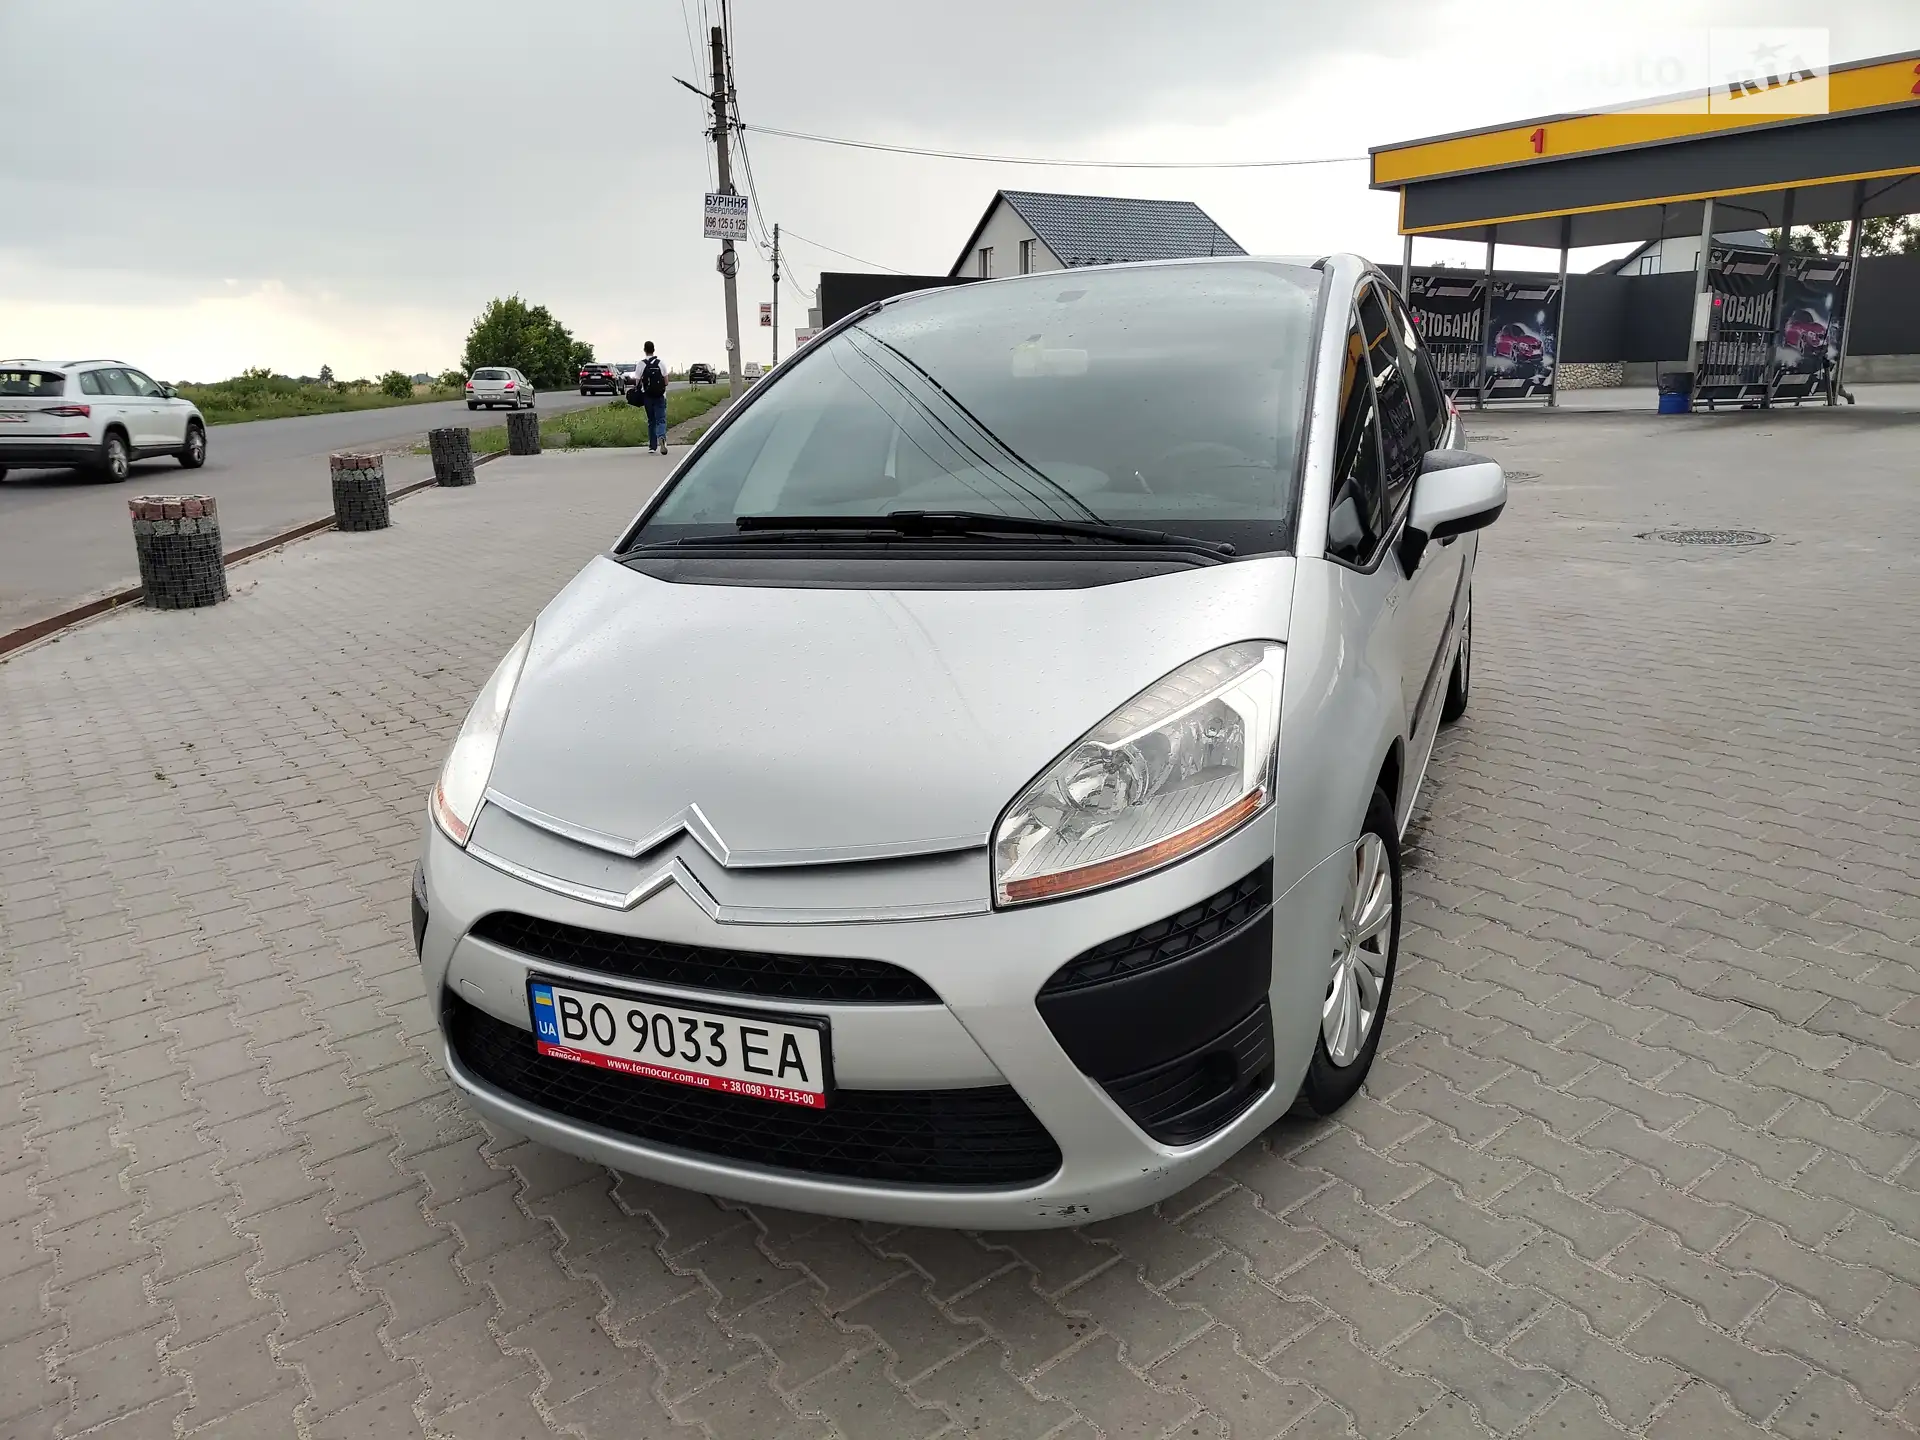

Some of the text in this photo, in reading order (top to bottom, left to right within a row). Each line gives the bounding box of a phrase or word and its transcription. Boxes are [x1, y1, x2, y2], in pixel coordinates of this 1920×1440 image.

[1530, 128, 1545, 154] 1
[705, 195, 748, 208] БУРІННЯ
[705, 206, 748, 216] СВЕРДЛОВИН
[705, 216, 746, 230] 096 125 5 125
[539, 1020, 558, 1037] UA
[558, 995, 810, 1083] BO 9033 EA
[606, 1058, 710, 1087] www.ternocar.com.ua
[769, 1088, 815, 1105] 175-15-00
